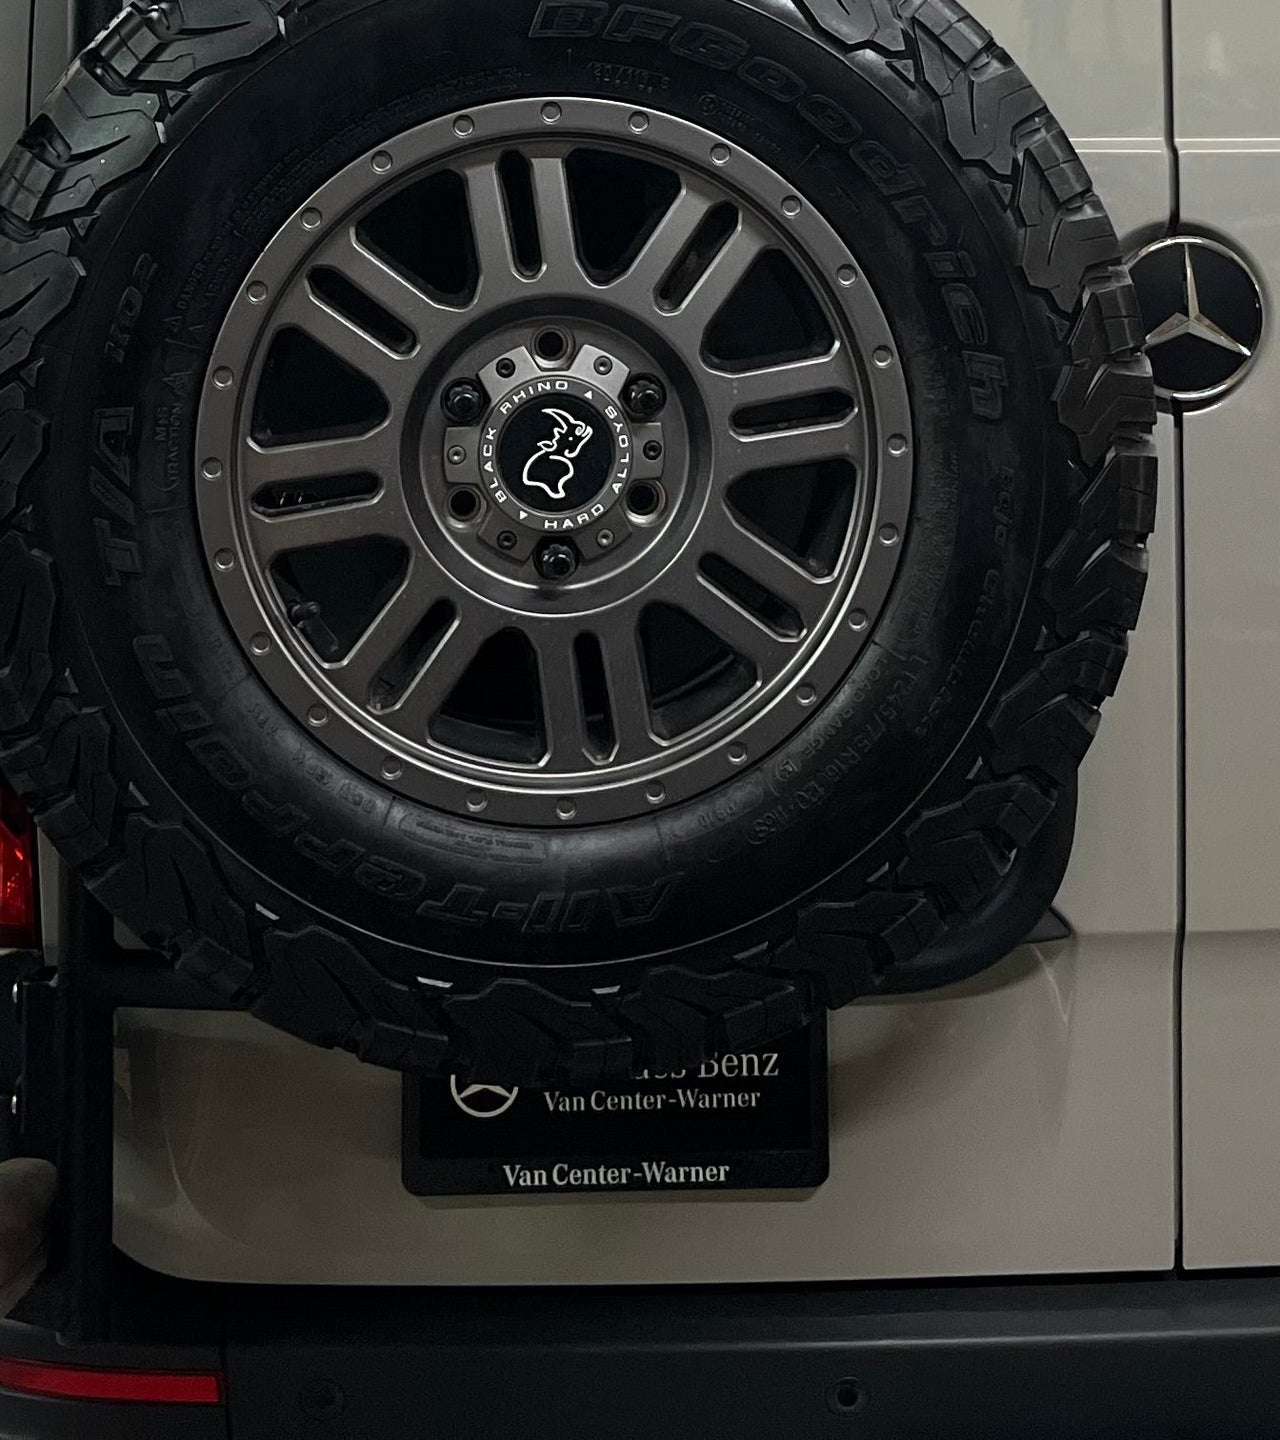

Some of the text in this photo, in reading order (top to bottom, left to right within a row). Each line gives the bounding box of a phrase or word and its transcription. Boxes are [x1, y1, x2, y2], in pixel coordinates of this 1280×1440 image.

[482, 380, 569, 504] BLACK RHINO
[544, 405, 630, 530] HARD ALLOYS
[543, 1088, 762, 1113] Van Center-Warner
[503, 1160, 730, 1187] Van Center-Warner
